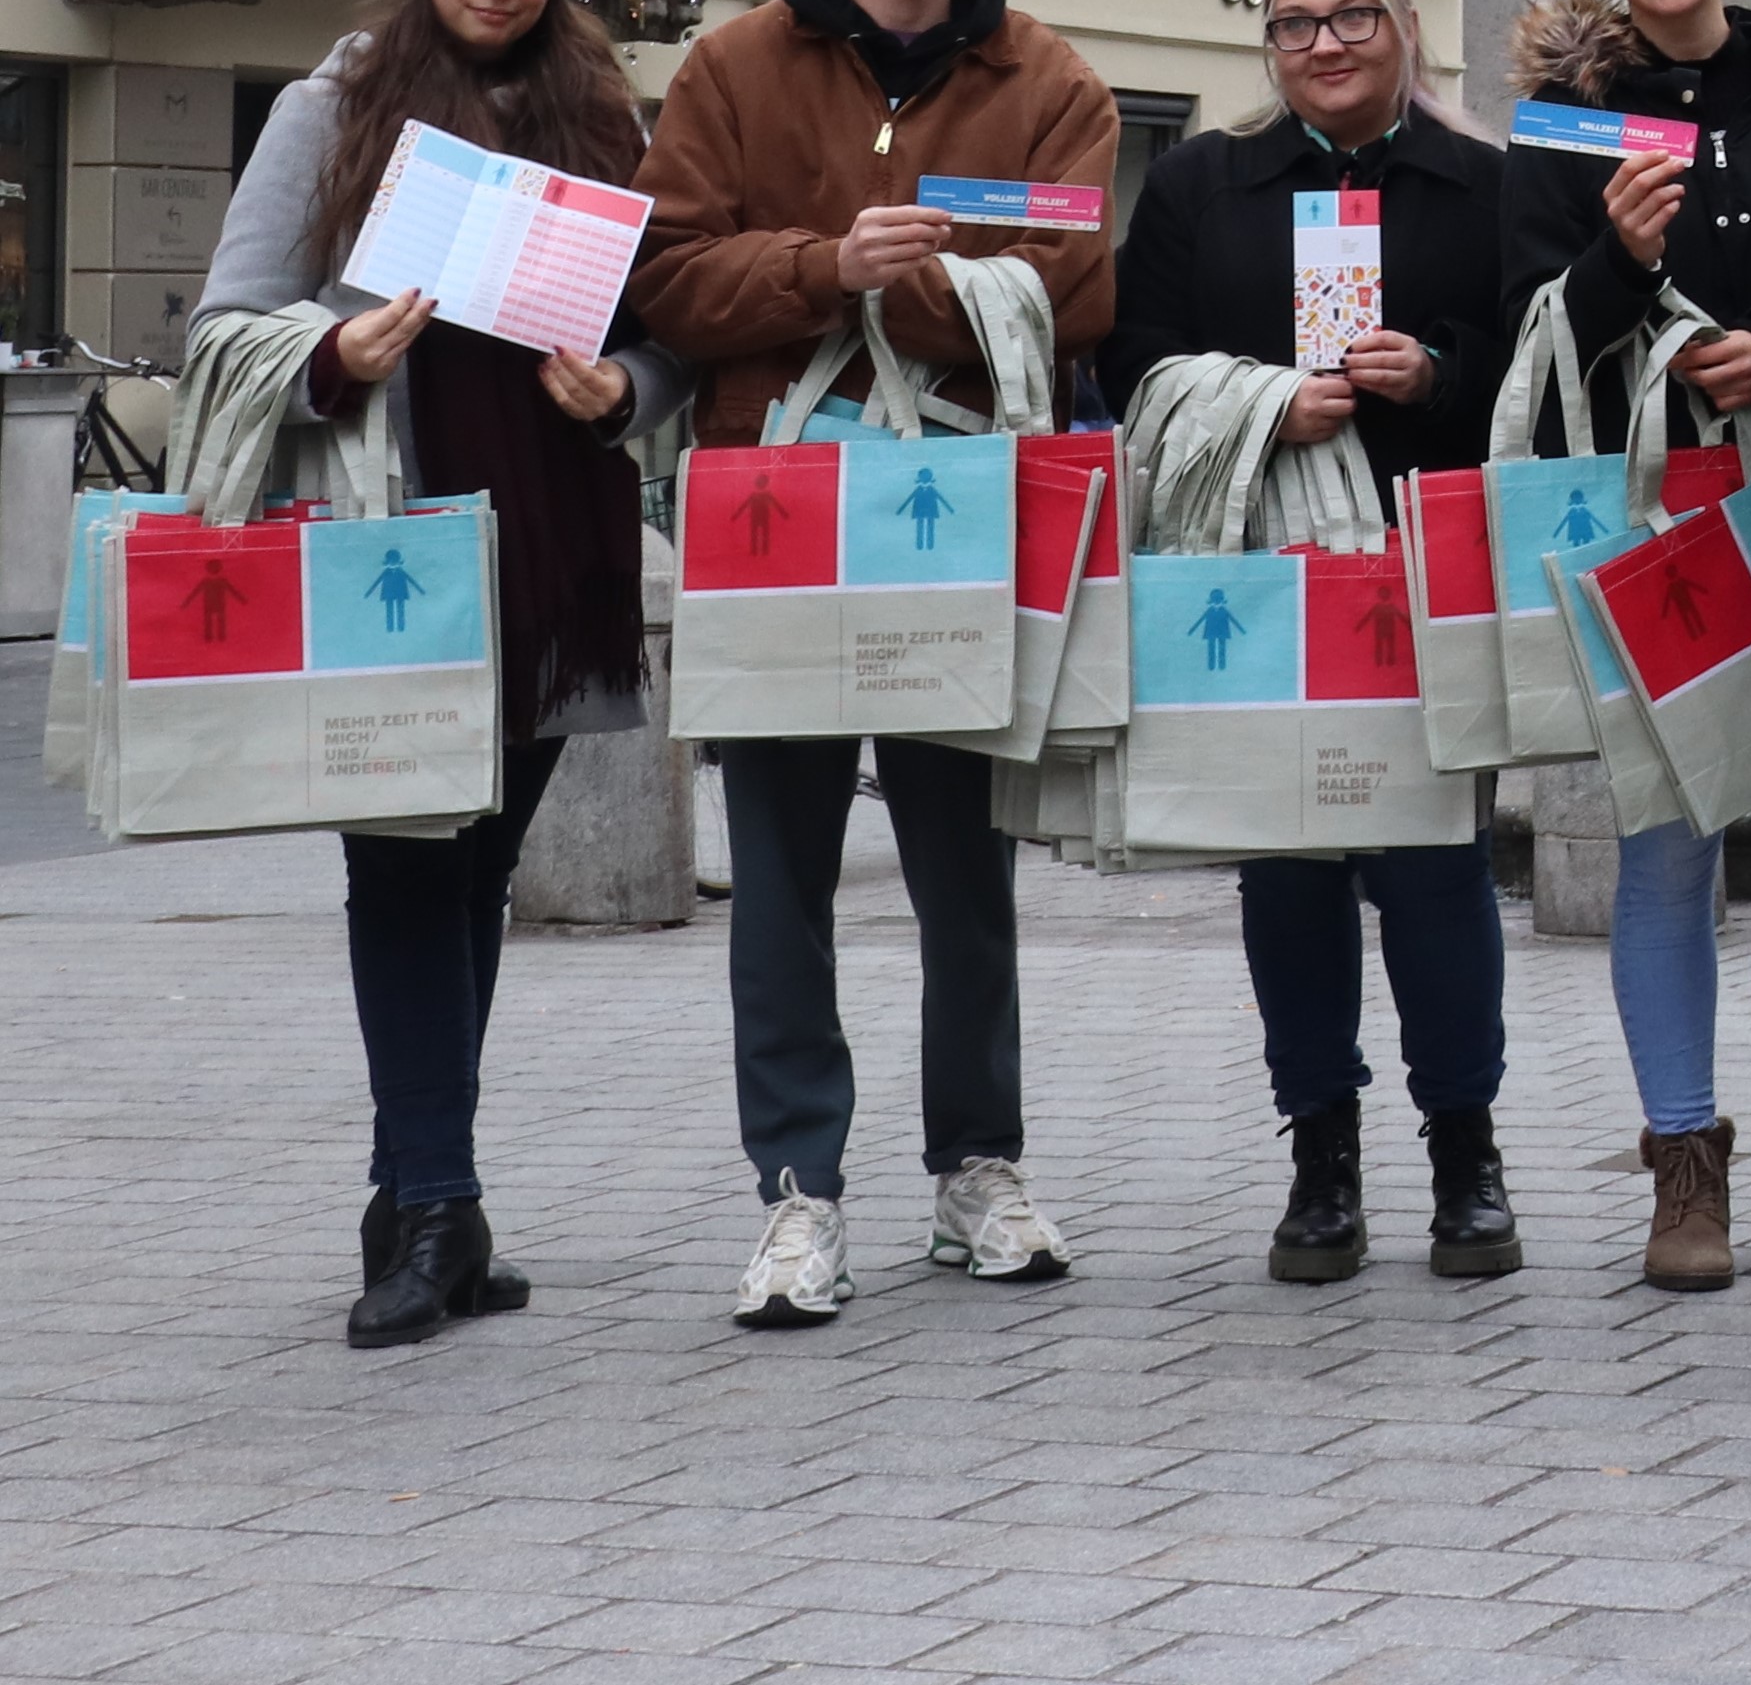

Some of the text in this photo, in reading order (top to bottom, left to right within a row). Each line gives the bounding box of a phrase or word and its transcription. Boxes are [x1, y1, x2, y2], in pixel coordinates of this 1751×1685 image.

[856, 627, 983, 645] MEHR ZEIT FÜR
[856, 678, 943, 692] ANDERE(S)
[325, 709, 459, 730] MEHR ZEIT FÜR
[1316, 747, 1348, 759] WIR
[325, 760, 417, 776] ANDERE(S)
[1316, 762, 1388, 774] MACHEN
[1317, 777, 1371, 790] HALBE
[1317, 792, 1371, 806] HALBE
